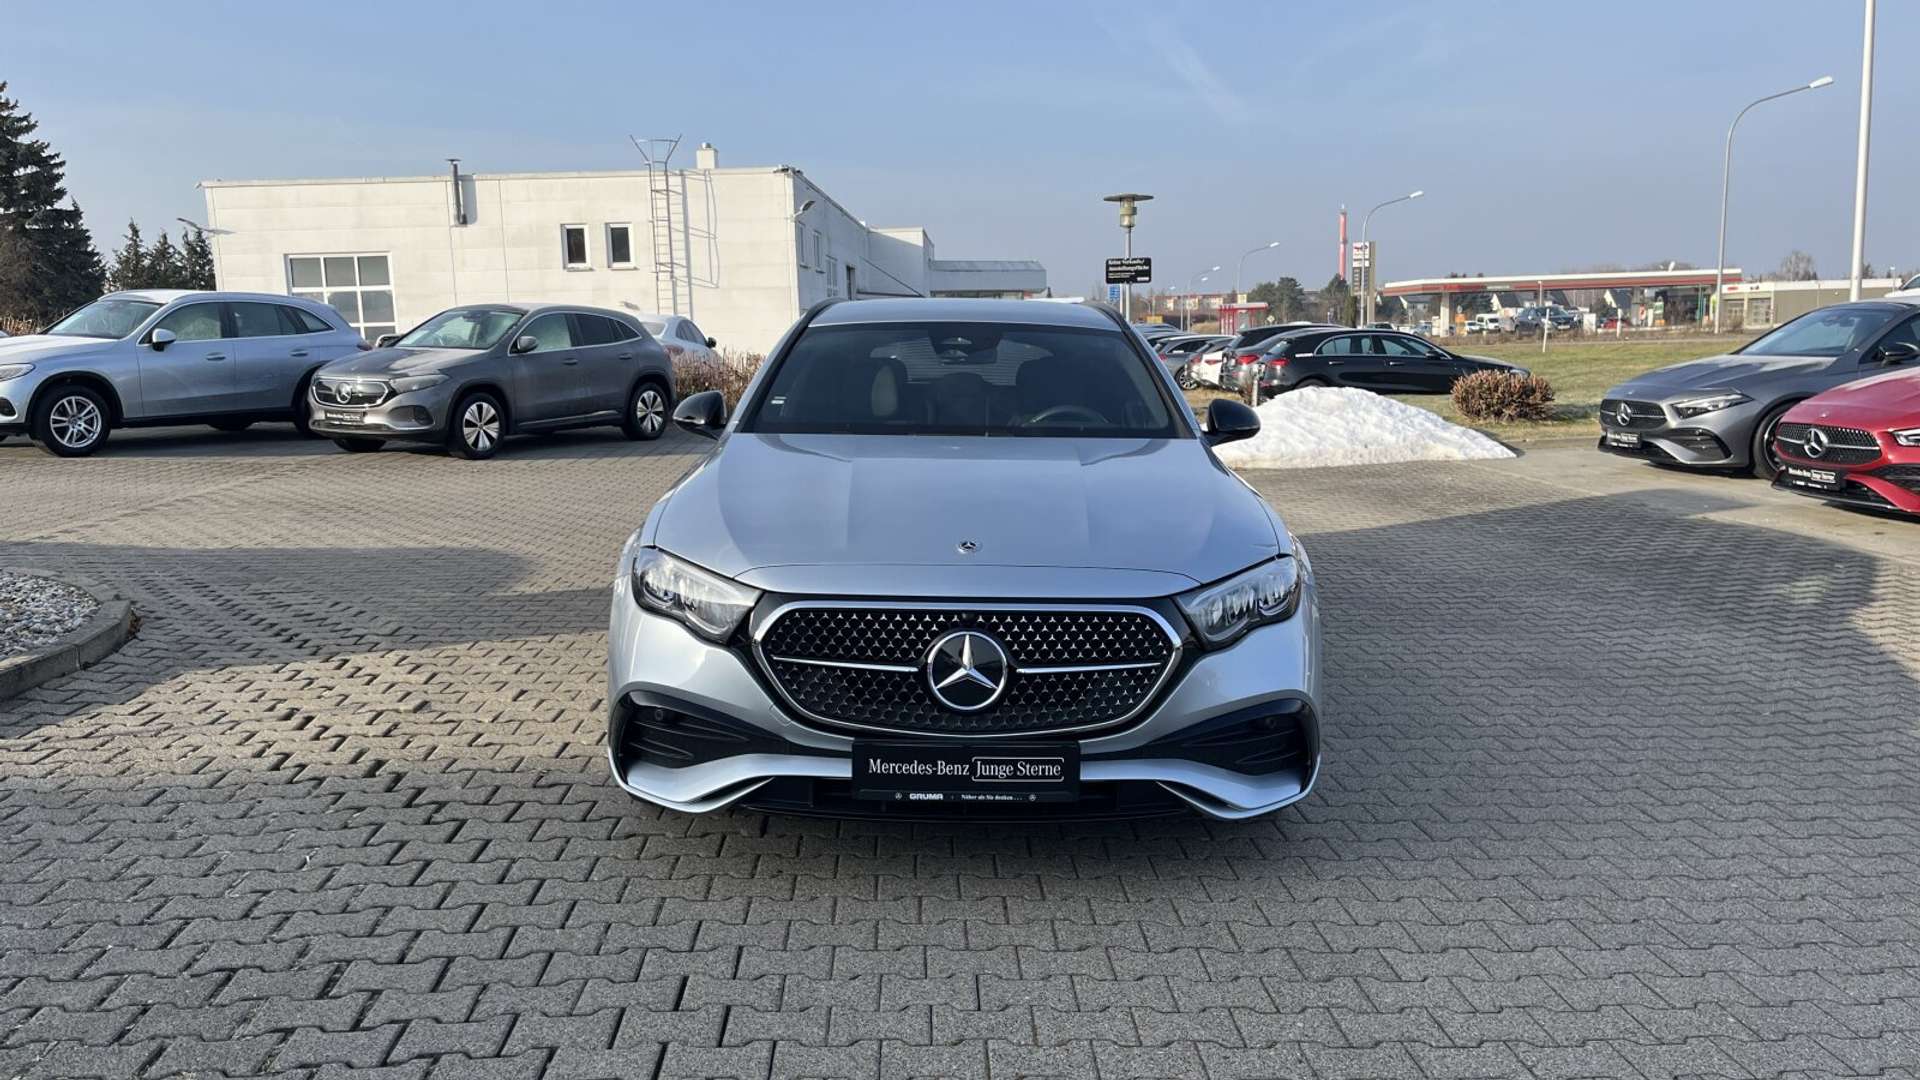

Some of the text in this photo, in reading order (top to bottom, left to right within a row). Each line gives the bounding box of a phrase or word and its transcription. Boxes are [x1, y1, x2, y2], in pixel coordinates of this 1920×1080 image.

[868, 758, 1061, 779] Mercedes-Benz Junge Sterne
